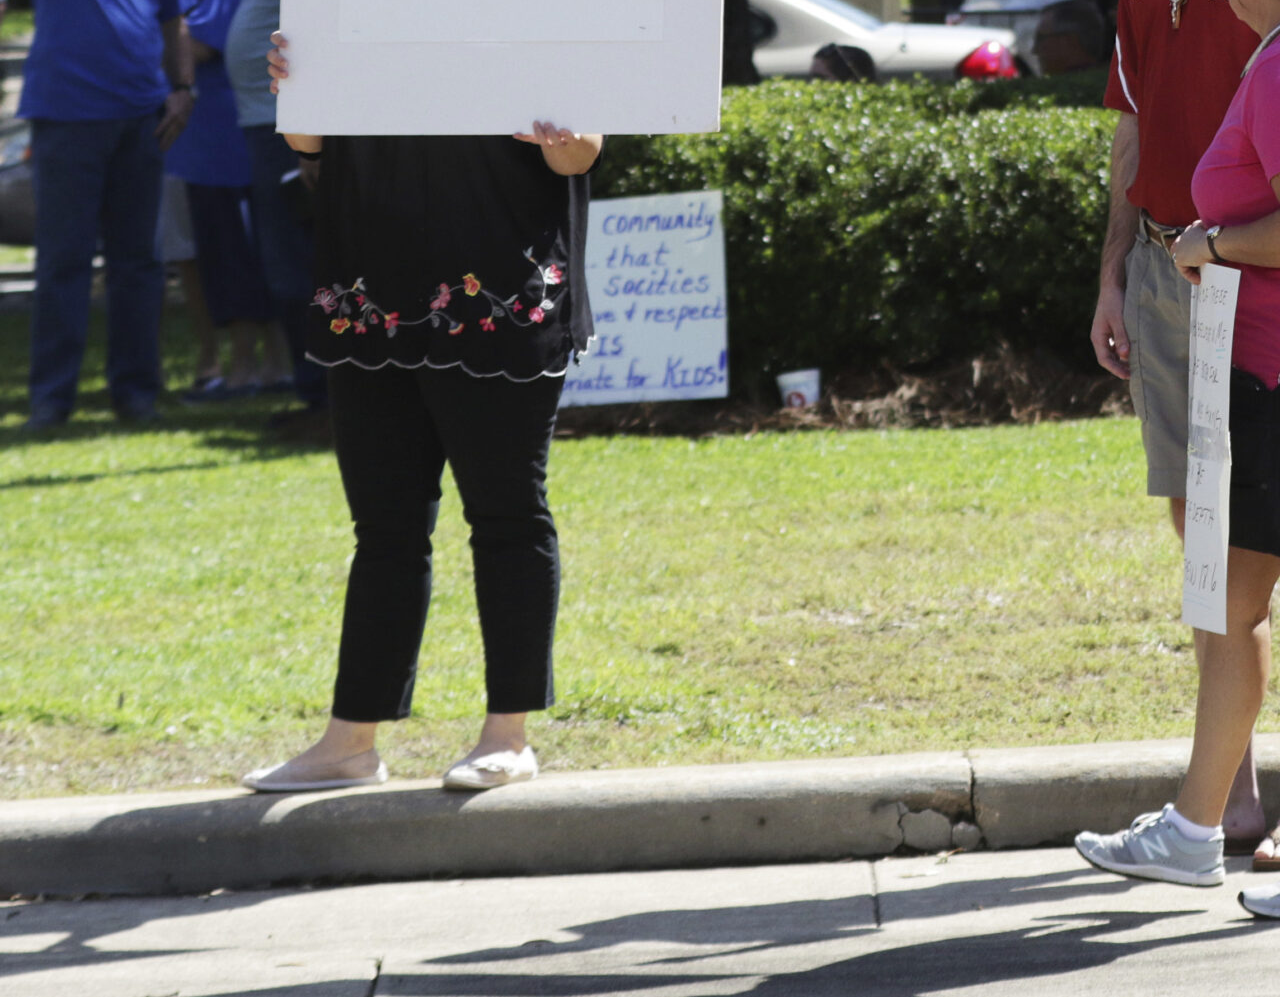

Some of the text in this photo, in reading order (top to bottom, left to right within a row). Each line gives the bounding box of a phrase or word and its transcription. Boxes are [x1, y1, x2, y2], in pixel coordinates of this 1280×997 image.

[606, 242, 671, 269] that
[643, 298, 727, 331] respect
[626, 357, 649, 389] for
[1140, 834, 1170, 861] N
